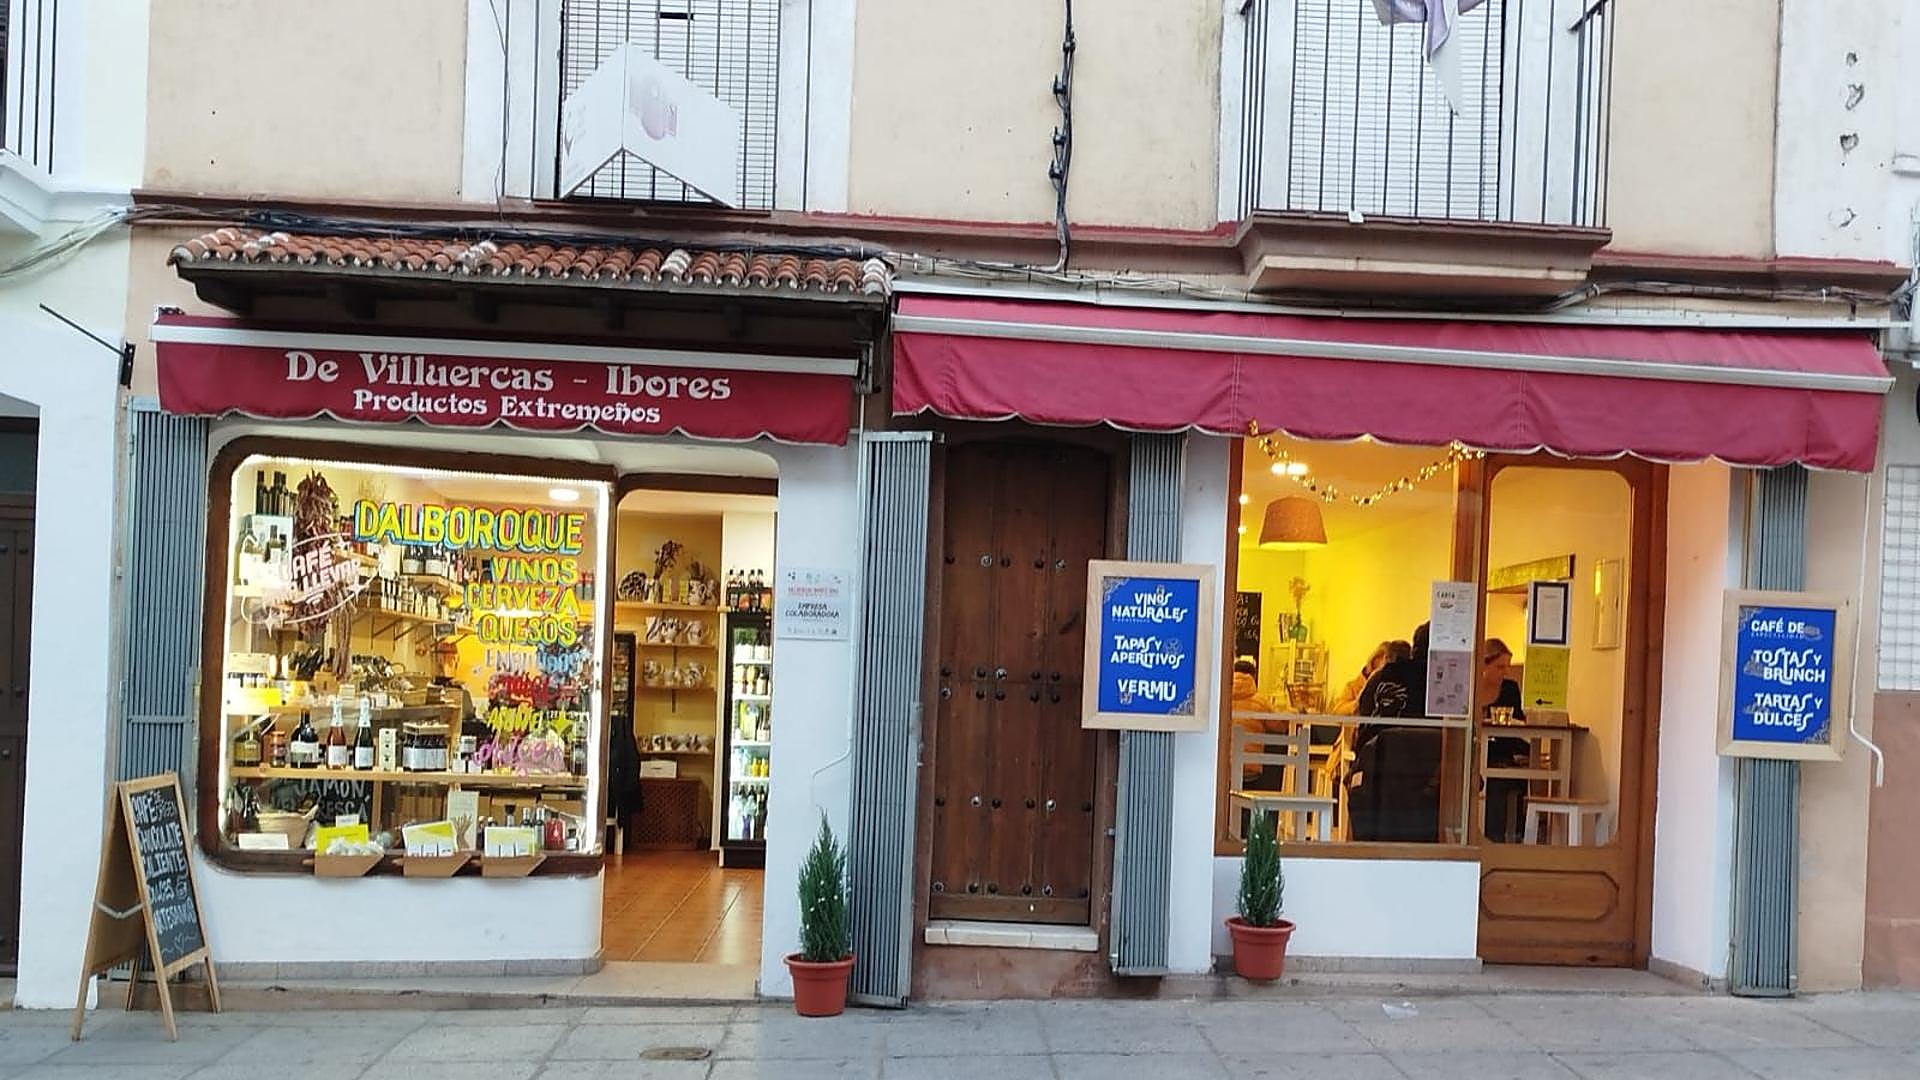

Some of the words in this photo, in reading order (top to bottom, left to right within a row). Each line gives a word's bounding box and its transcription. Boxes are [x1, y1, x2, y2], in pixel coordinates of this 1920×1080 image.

[285, 351, 339, 384] De
[358, 353, 554, 392] Villuercas
[604, 364, 731, 401] Ibores
[353, 388, 488, 416] Productos
[501, 395, 662, 425] Extremeños
[355, 499, 587, 554] DALBOROQUE
[490, 556, 578, 584] VINOS
[465, 581, 580, 616] CERVEZA
[798, 602, 828, 610] EMPRESA
[1134, 592, 1173, 607] VINOS
[1112, 605, 1188, 623] NATURALES
[479, 613, 578, 647] QUESOS
[1751, 617, 1783, 634] CAFÉ
[1788, 622, 1805, 635] DE
[1114, 635, 1156, 653] TAPAS
[1154, 640, 1163, 651] Y
[1110, 652, 1185, 670] APERITIVOS
[1753, 648, 1813, 668] TOSTAS
[1813, 654, 1822, 667] Y
[1763, 667, 1826, 686] BRUNCH
[1117, 679, 1177, 702] VERMÚ
[1754, 693, 1813, 713] TARTAS
[1814, 698, 1823, 710] Y
[1753, 711, 1814, 732] DULCES
